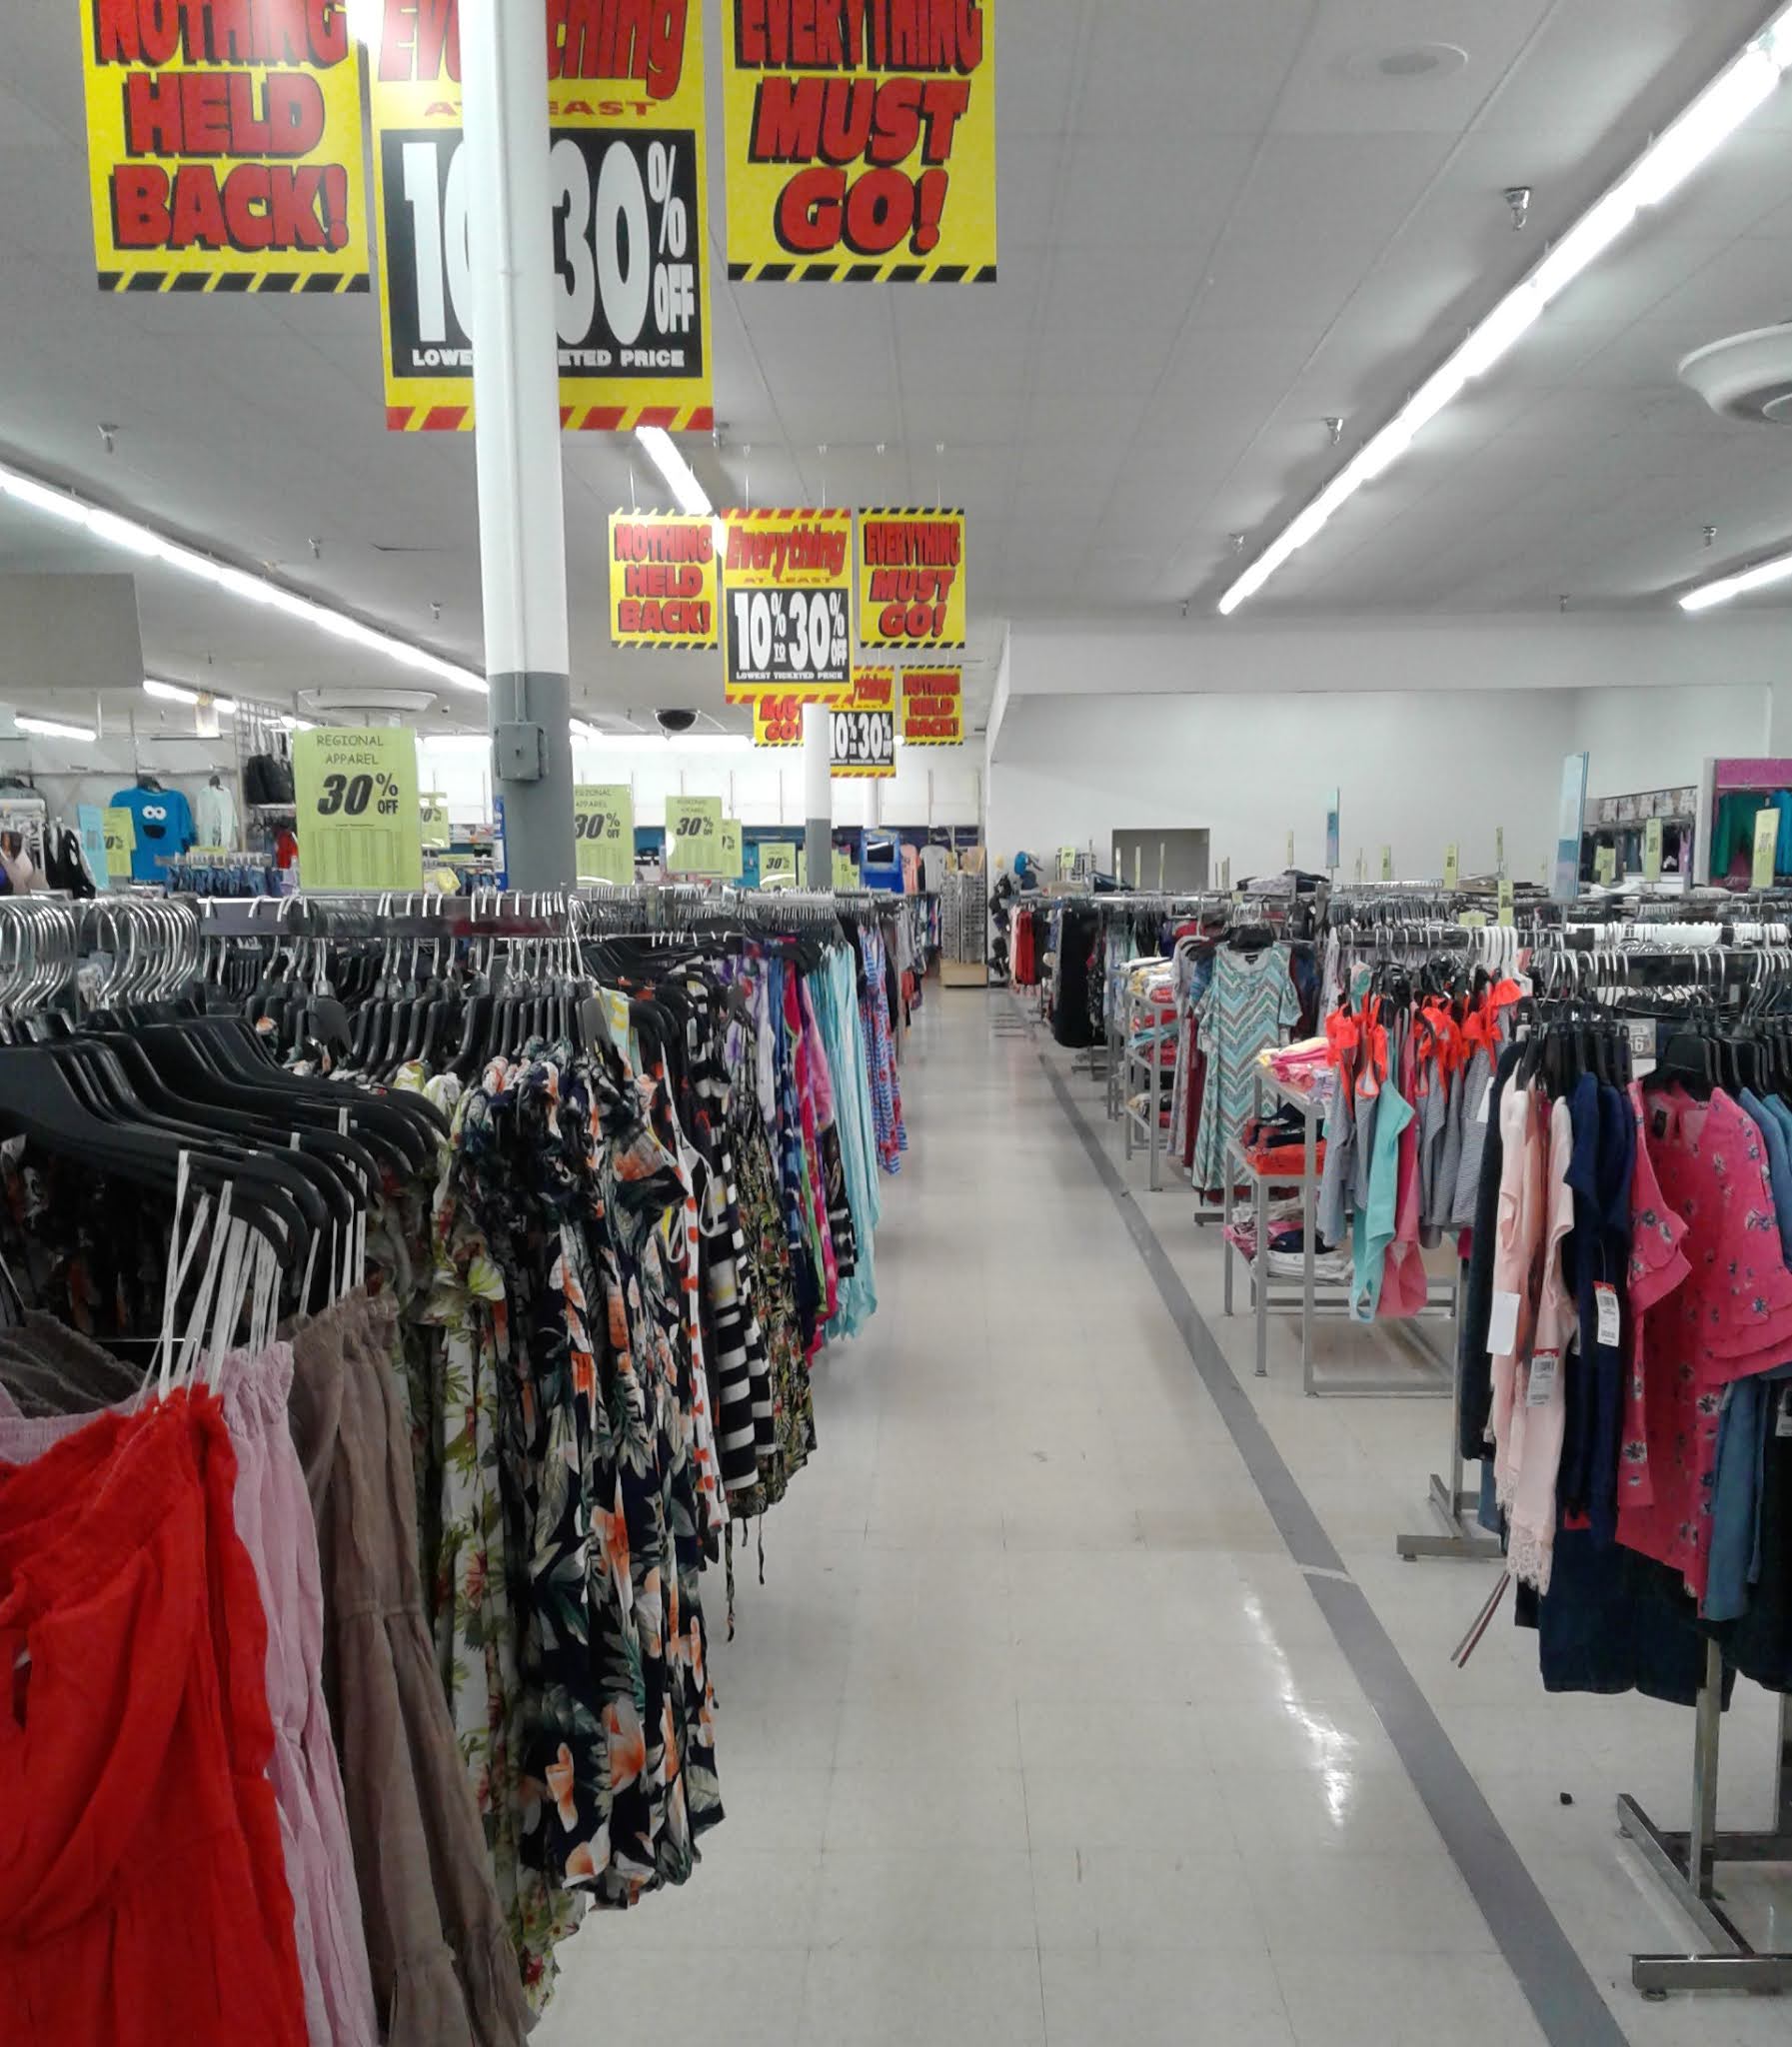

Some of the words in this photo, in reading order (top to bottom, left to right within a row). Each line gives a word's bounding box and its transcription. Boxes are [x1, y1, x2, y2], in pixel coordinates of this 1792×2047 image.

[95, 0, 349, 67] NOTHING
[735, 0, 982, 75] EVERYTHING
[123, 72, 325, 158] HELD
[748, 76, 971, 167] MUST
[109, 164, 349, 252] BACK!
[774, 165, 948, 256] GO!
[654, 262, 696, 335] OFF
[621, 350, 685, 367] PRICE
[615, 523, 713, 563] NOTHING
[726, 523, 847, 580] Everything
[864, 521, 960, 567] EVERYTHING
[625, 564, 704, 599] HELD
[869, 568, 955, 602] MUST
[618, 600, 711, 634] BACK!
[878, 602, 948, 638] GO!
[831, 638, 848, 667] OFF
[316, 735, 385, 747] REGIONAL
[325, 753, 379, 765] APPAREL
[377, 800, 399, 815] OFF
